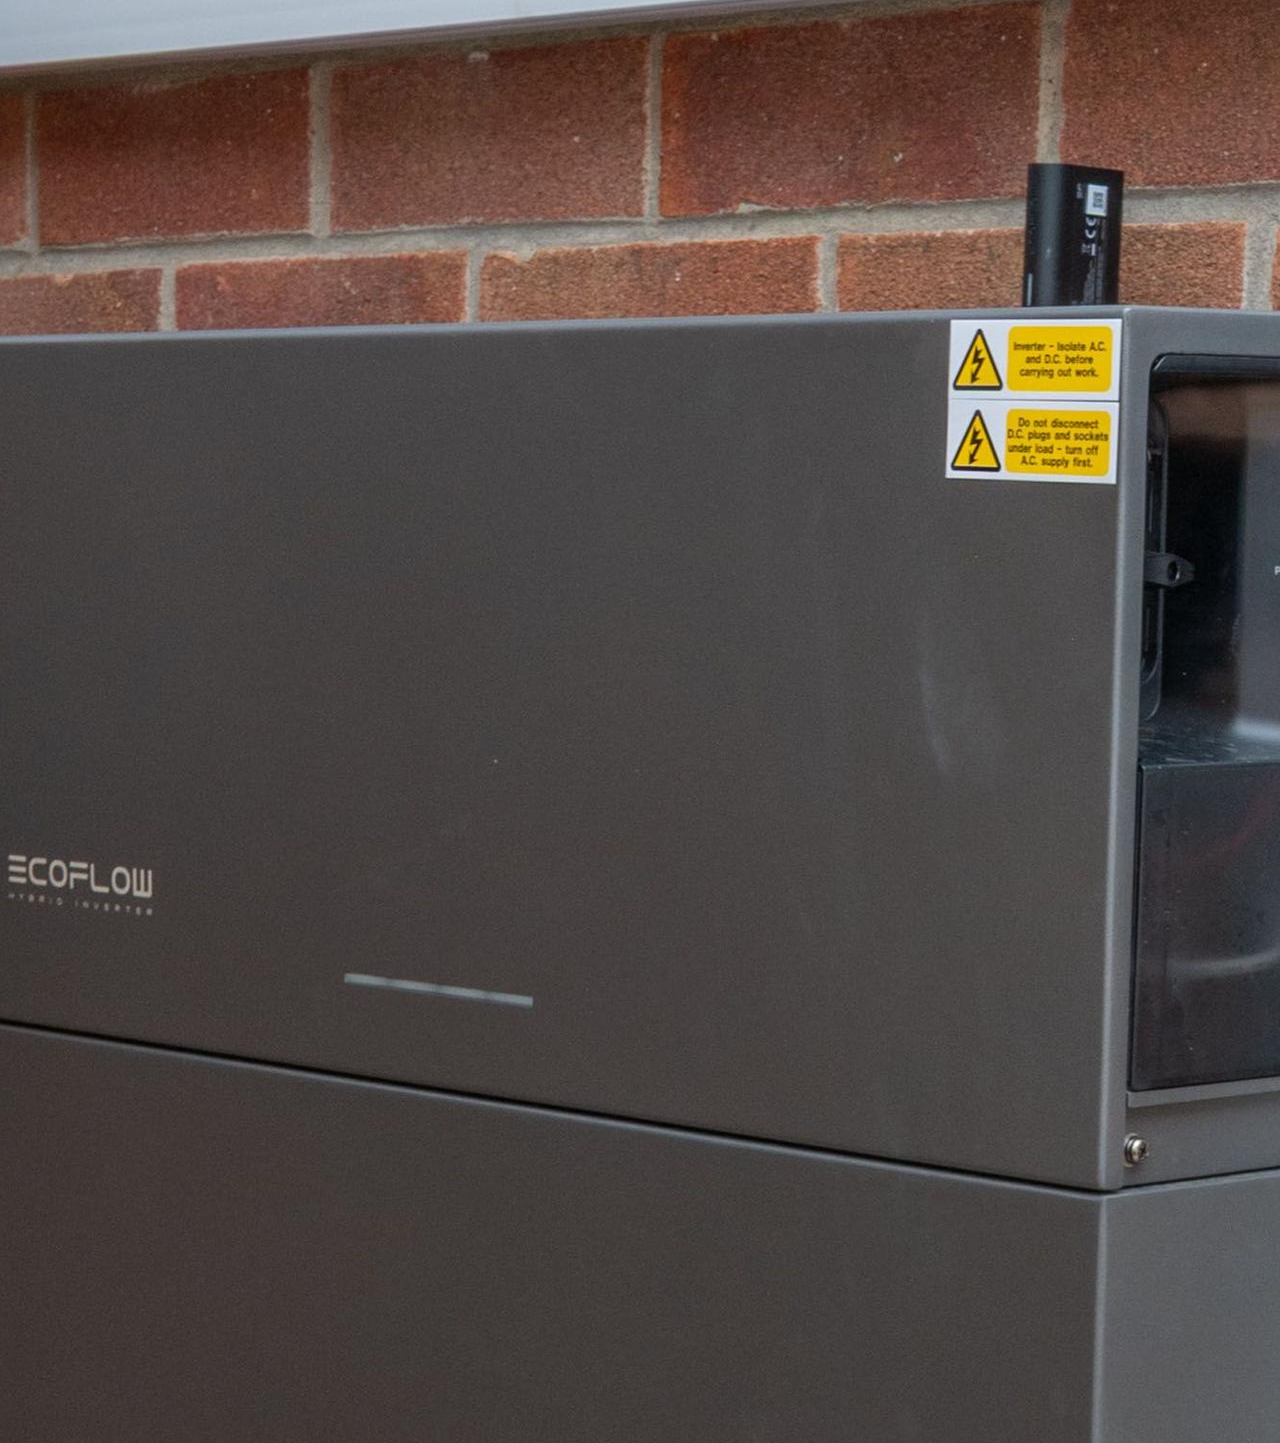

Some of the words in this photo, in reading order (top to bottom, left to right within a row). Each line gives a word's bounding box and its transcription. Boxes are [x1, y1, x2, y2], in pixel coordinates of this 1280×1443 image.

[1013, 342, 1046, 351] Inverter
[1057, 342, 1085, 351] Isolate
[1090, 342, 1106, 351] A.C.
[1025, 355, 1041, 364] and
[1044, 355, 1062, 364] D.C.
[1065, 355, 1093, 364] before
[1019, 368, 1054, 379] carrying
[1057, 368, 1071, 377] out
[1075, 368, 1099, 377] work.
[1018, 418, 1030, 428] Do
[1034, 419, 1047, 428] not
[1051, 419, 1099, 429] disconnect
[1007, 429, 1023, 439] D.C.
[1028, 430, 1050, 441] plugs
[1055, 430, 1070, 440] and
[1074, 431, 1109, 441] sockets
[1008, 443, 1031, 453] under
[1035, 443, 1054, 454] load
[1065, 445, 1082, 455] turn
[1086, 445, 1099, 455] off
[1021, 456, 1037, 465] A.C.
[1041, 457, 1069, 468] supply
[1073, 457, 1093, 468] first.
[8, 854, 153, 898] ECOFLOW
